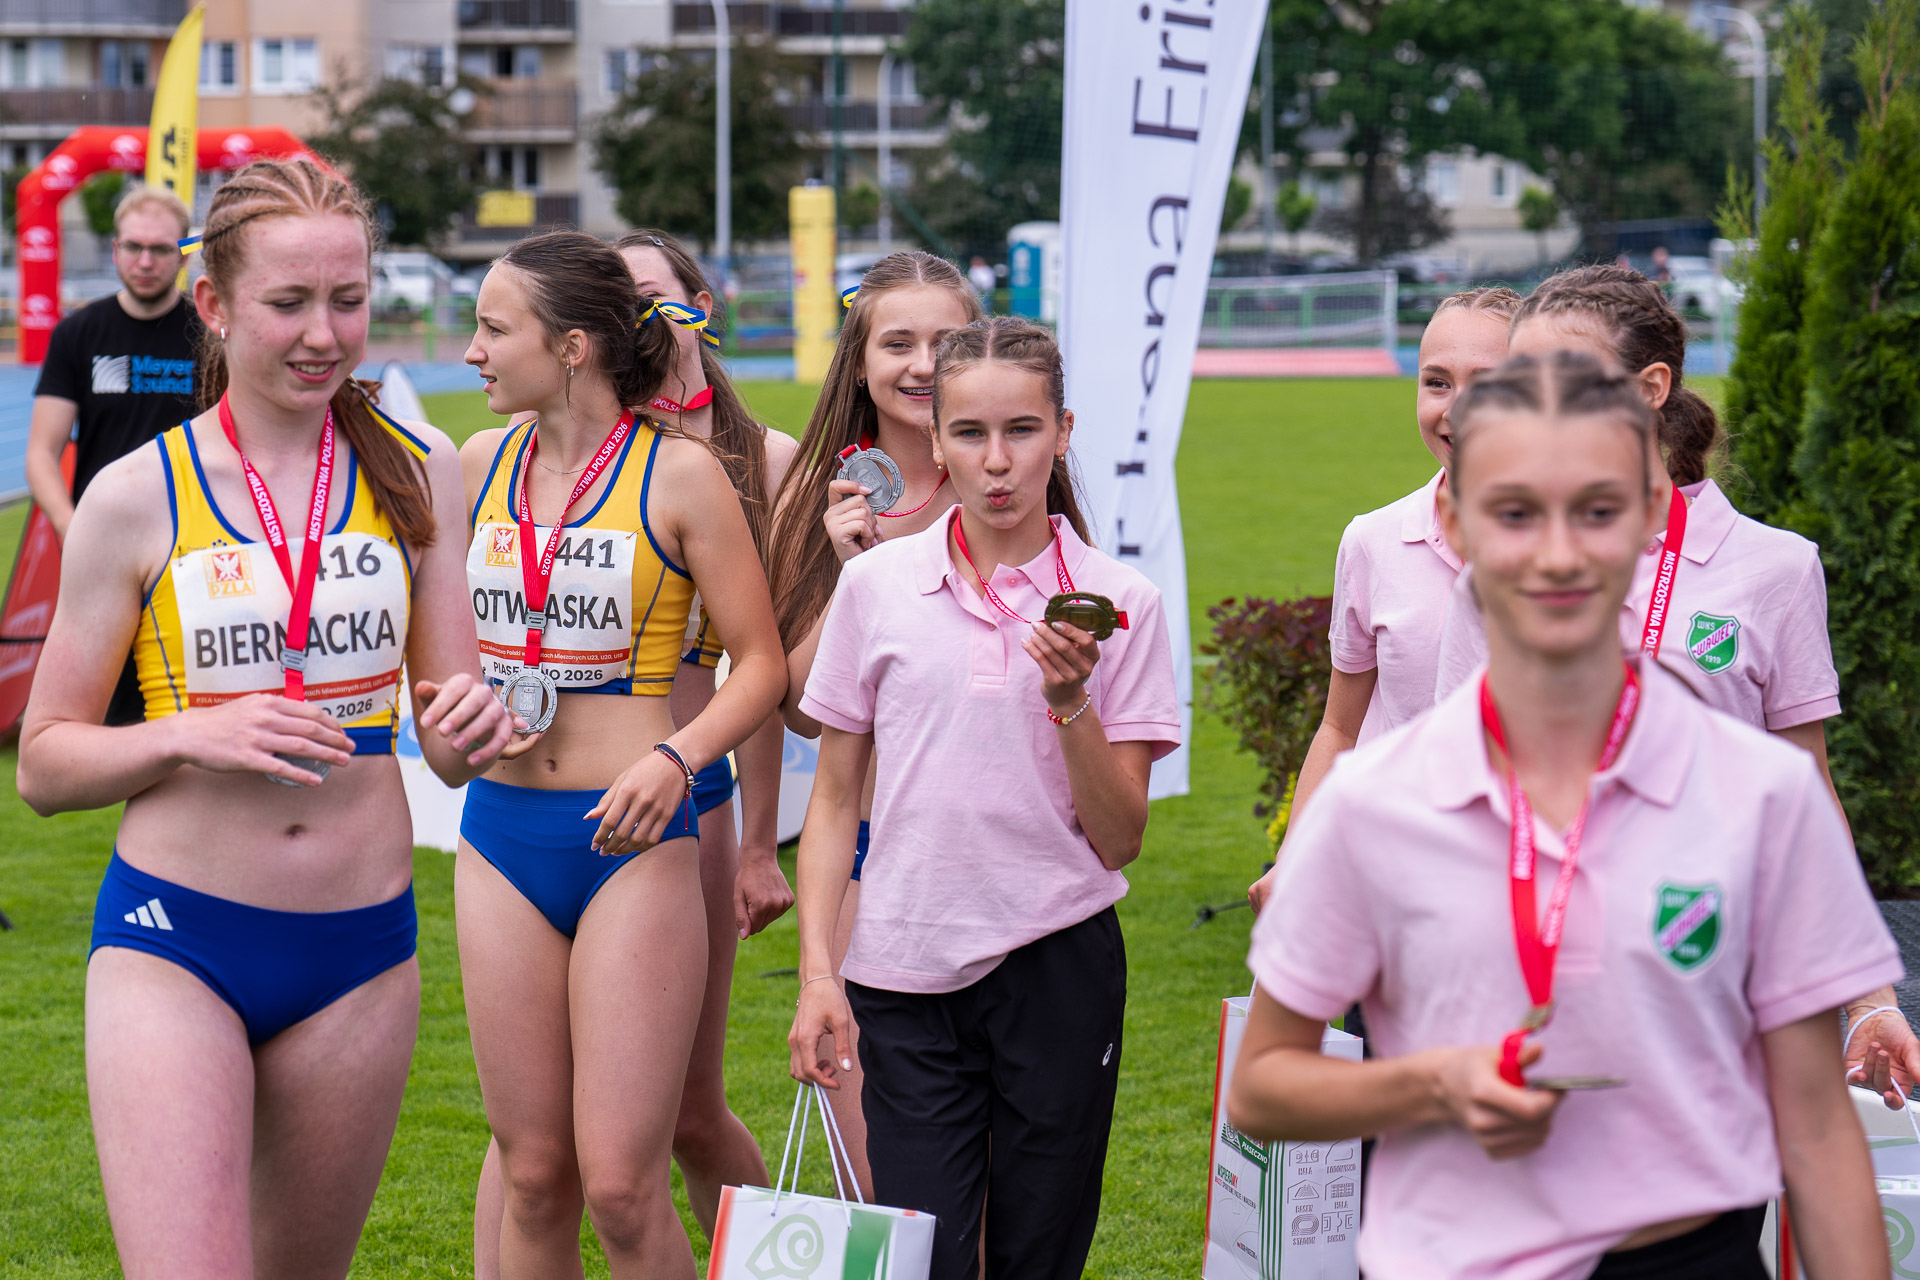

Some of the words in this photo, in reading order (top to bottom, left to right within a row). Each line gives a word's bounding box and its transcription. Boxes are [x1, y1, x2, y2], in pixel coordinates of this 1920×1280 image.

[131, 355, 194, 378] Meyer
[131, 376, 194, 394] Sound
[592, 441, 617, 472] POLSKI
[611, 422, 629, 444] 2026
[308, 466, 331, 542] MISTRZOSTWA
[321, 426, 334, 466] POLSKI
[247, 471, 283, 547] MISTRZOSTWA
[547, 517, 563, 552] POLSKI
[487, 554, 516, 566] PZLA
[541, 552, 553, 576] 2026
[211, 580, 253, 597] PZLA
[1648, 550, 1676, 627] MISTRZOSTWA
[554, 653, 587, 662] Mieszanych
[564, 669, 603, 681] 2026
[321, 683, 360, 695] Mieszanych
[336, 698, 373, 718] 2026
[1241, 1141, 1268, 1164] PIASECZNO
